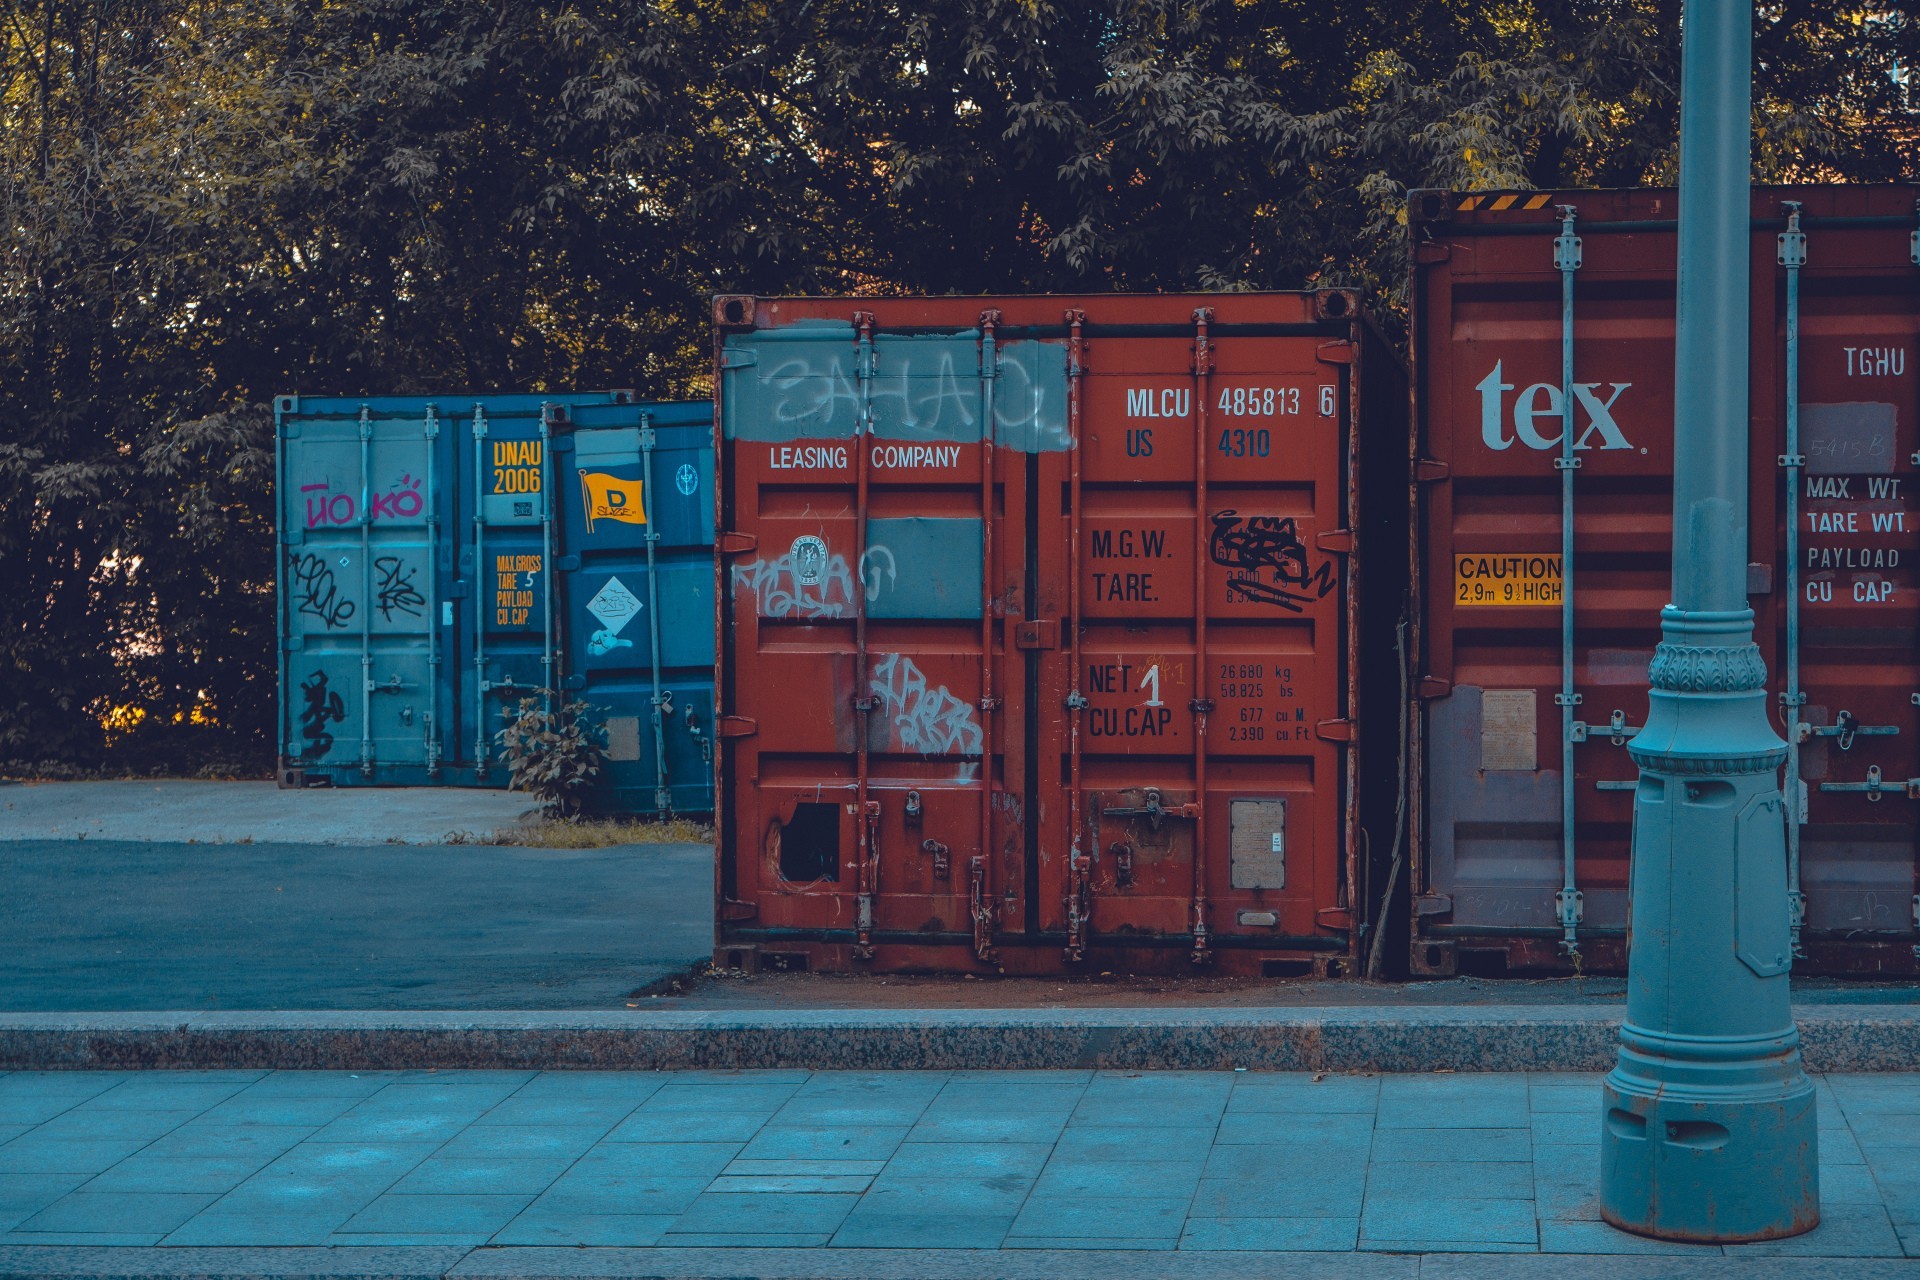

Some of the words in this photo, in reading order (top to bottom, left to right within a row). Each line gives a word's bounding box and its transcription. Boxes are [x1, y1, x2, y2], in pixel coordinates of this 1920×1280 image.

[1844, 347, 1905, 376] TGHU
[1127, 387, 1190, 418] MLCU
[1218, 387, 1301, 417] 485813
[1320, 387, 1334, 417] 6
[1475, 358, 1634, 451] tex
[494, 441, 542, 466] DNAU
[1127, 429, 1153, 457] US
[1218, 429, 1270, 457] 4310
[770, 447, 848, 469] LEASING
[871, 446, 961, 468] COMPANY
[493, 468, 541, 494] 2006
[1868, 477, 1905, 500] WT.
[606, 490, 627, 507] D
[1807, 513, 1858, 533] TARE
[1872, 513, 1911, 533] WT.
[1092, 530, 1172, 559] M.G.W.
[497, 555, 542, 573] MAX.GROSS
[1459, 557, 1562, 579] CAUTION
[1808, 548, 1899, 568] PAYLOAD
[498, 573, 517, 590] TARE
[524, 570, 537, 587] 5
[1093, 573, 1159, 602] TARE.
[497, 591, 533, 608] PAYLOAD
[1459, 582, 1495, 604] 2,9m
[1523, 582, 1562, 601] HIGH
[1806, 582, 1832, 602] CU
[1853, 582, 1895, 603] CAP.
[1089, 665, 1139, 693] NET.
[1220, 665, 1263, 679] 26.680
[1140, 664, 1164, 706] 1
[1089, 708, 1178, 737] CU.CAP.
[1229, 726, 1264, 741] 2.390
